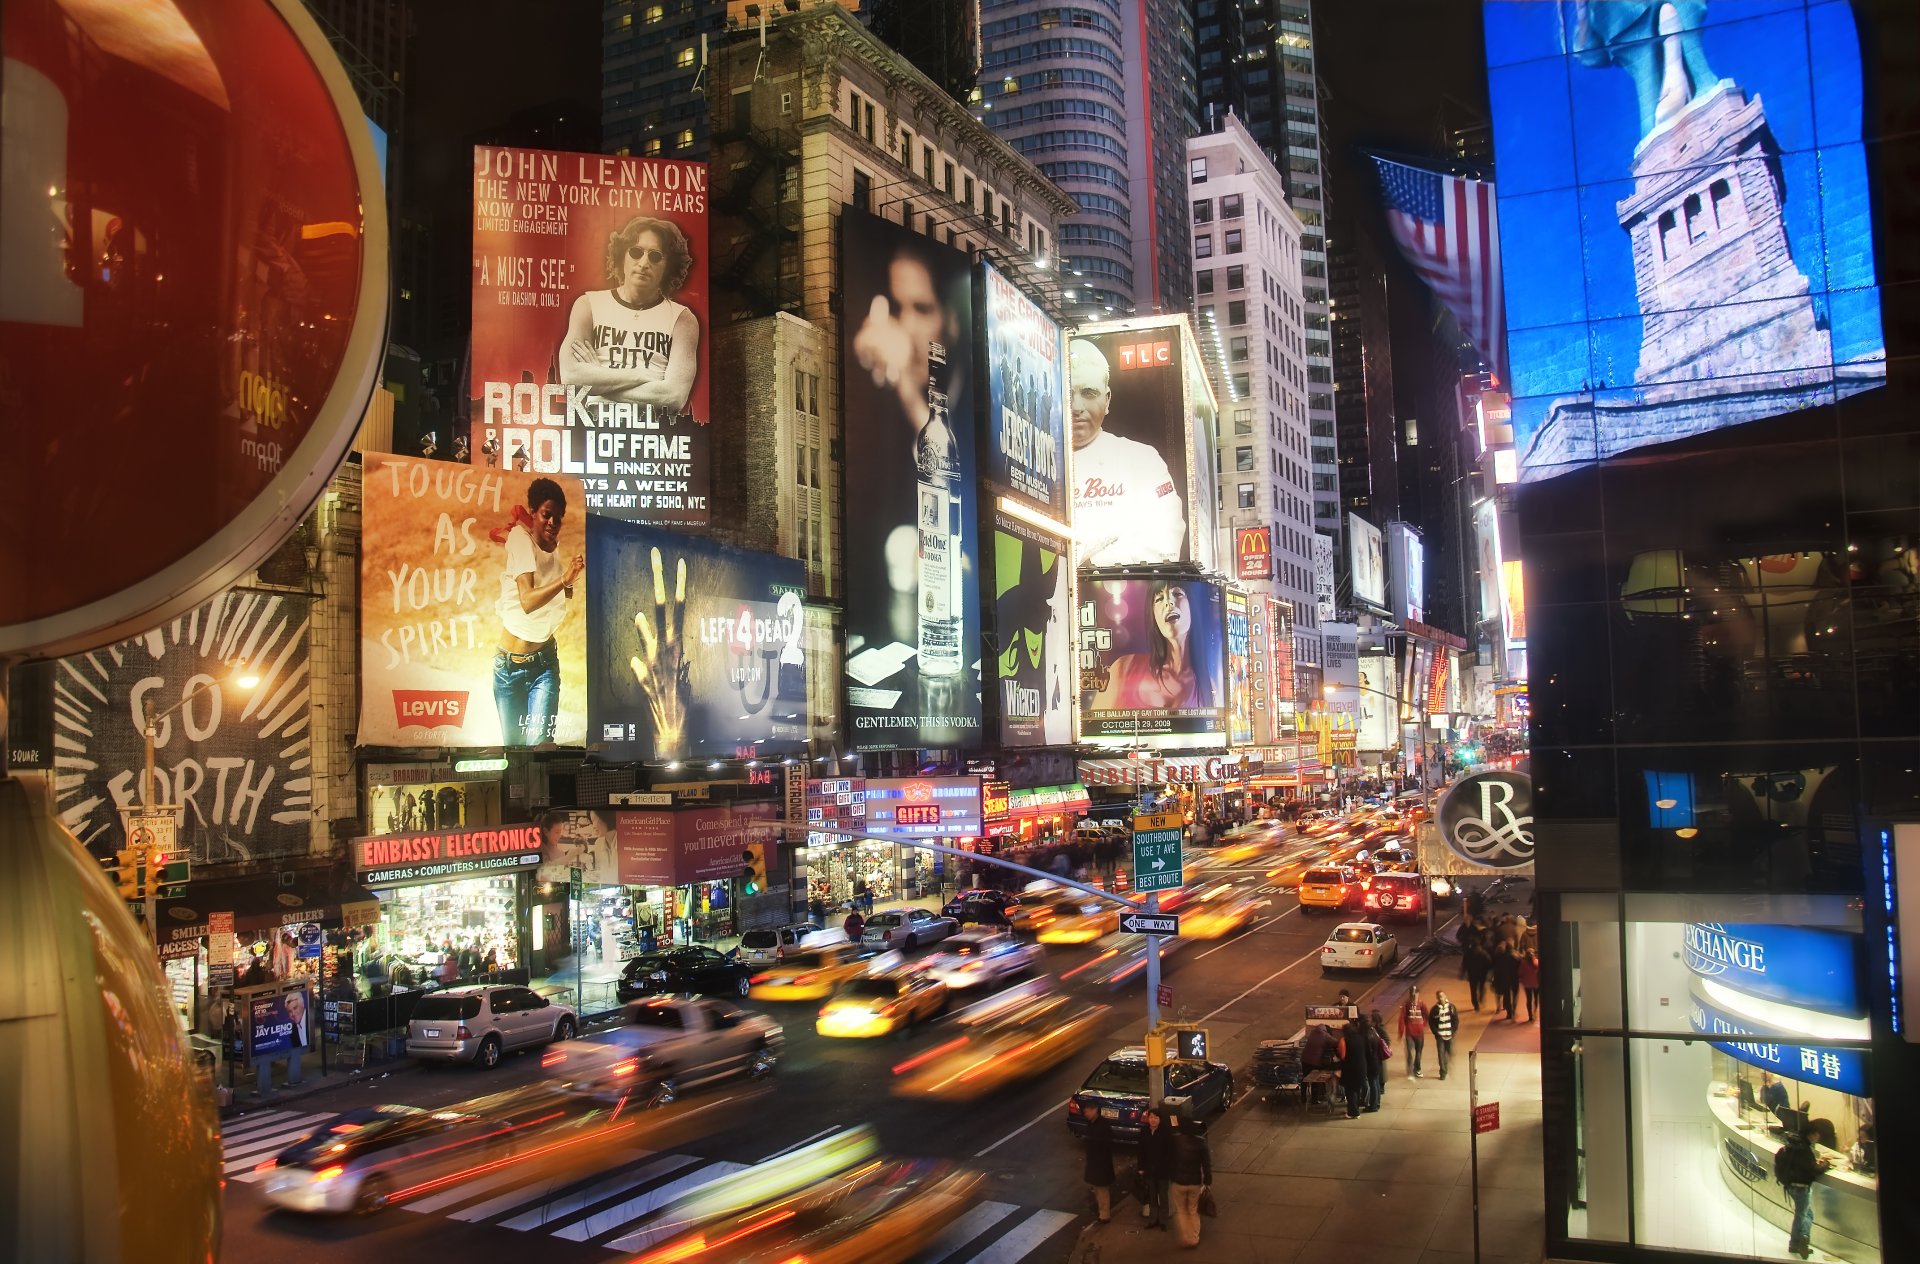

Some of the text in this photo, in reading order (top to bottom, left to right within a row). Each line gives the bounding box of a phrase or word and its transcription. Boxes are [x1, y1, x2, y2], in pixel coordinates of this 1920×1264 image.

[478, 149, 558, 182] JOHN
[478, 178, 704, 214] THE NEW YORK CITY YEARS
[477, 203, 568, 222] NOW OPEN
[477, 217, 568, 236] LIMITED ENGAGEMENT
[497, 257, 533, 288] MUST
[498, 290, 511, 305] KEN
[592, 324, 673, 362] NEW YORK
[608, 347, 654, 369] CITY
[1121, 346, 1169, 365] TLC
[483, 381, 660, 430] ROCK HALL
[502, 427, 691, 474] ROLL OF FAME
[1000, 405, 1057, 482] JERSEY BOYS
[614, 462, 692, 477] ANNEX NYC
[381, 460, 503, 512] TOUGH
[616, 480, 688, 492] A WEEK
[1010, 465, 1050, 495] BEST MUSICAL
[1084, 477, 1126, 499] Boss
[585, 495, 604, 508] THE
[606, 495, 637, 508] HEART
[641, 495, 653, 509] OF
[688, 496, 706, 510] NYC
[434, 512, 478, 557] AS
[933, 534, 946, 551] One
[1241, 569, 1268, 577] HOURS
[1246, 560, 1263, 570] 24
[387, 562, 477, 614] YOUR
[700, 617, 735, 644] LEFT
[736, 609, 753, 651] 4
[756, 617, 792, 644] DEAD
[1227, 613, 1248, 637] SOUTH
[380, 615, 485, 670] SPIRIT.
[1326, 642, 1356, 653] MAXIMUM
[1251, 604, 1265, 710] PALACE
[1326, 652, 1357, 660] PERFORMANCE
[1326, 659, 1342, 668] LIVES
[1080, 676, 1110, 692] City
[130, 673, 223, 749] GO
[1106, 710, 1131, 718] BALLAD
[1132, 709, 1141, 717] OF
[1141, 709, 1152, 717] GAY
[1328, 699, 1358, 713] maxell
[521, 727, 544, 735] TIMES
[855, 716, 980, 729] GENTLEMEN, THIS IS VODKA.
[1101, 720, 1140, 729] OCTOBER
[1154, 719, 1171, 728] 2009
[12, 750, 39, 763] SQUARE
[393, 768, 428, 783] BROADWAY
[823, 781, 836, 792] GIFT
[838, 780, 849, 791] NYC
[852, 780, 864, 790] GIFT
[932, 788, 978, 798] BROADWAY
[107, 757, 276, 838] FORTH
[838, 793, 851, 804] GIFT
[853, 792, 864, 802] NYC
[984, 797, 1008, 814] STEAKS
[809, 809, 821, 820] NYC
[852, 804, 864, 815] GIFT
[898, 806, 938, 823] GIFTS
[695, 817, 719, 832] Come
[719, 814, 743, 831] spend
[1150, 816, 1166, 827] NEW
[707, 831, 738, 849] never
[810, 833, 836, 845] NYC GIFT
[1136, 830, 1180, 845] SOUTHBOUND
[364, 827, 542, 867] EMBASSY ELECTRONICS
[1140, 843, 1176, 856] USE 7 AVE
[367, 868, 413, 883] CAMERAS
[420, 861, 474, 876] COMPUTERS
[480, 856, 518, 870] LUGGAGE
[1139, 872, 1179, 889] BEST ROUTE
[281, 909, 325, 925] SMILER'S
[1128, 918, 1171, 930] ONE WAY
[1685, 922, 1766, 973] EXCHANGE
[255, 1022, 293, 1038] JAY LENO
[1713, 1016, 1781, 1064] CHANGE
[1800, 1047, 1841, 1080] 両替
